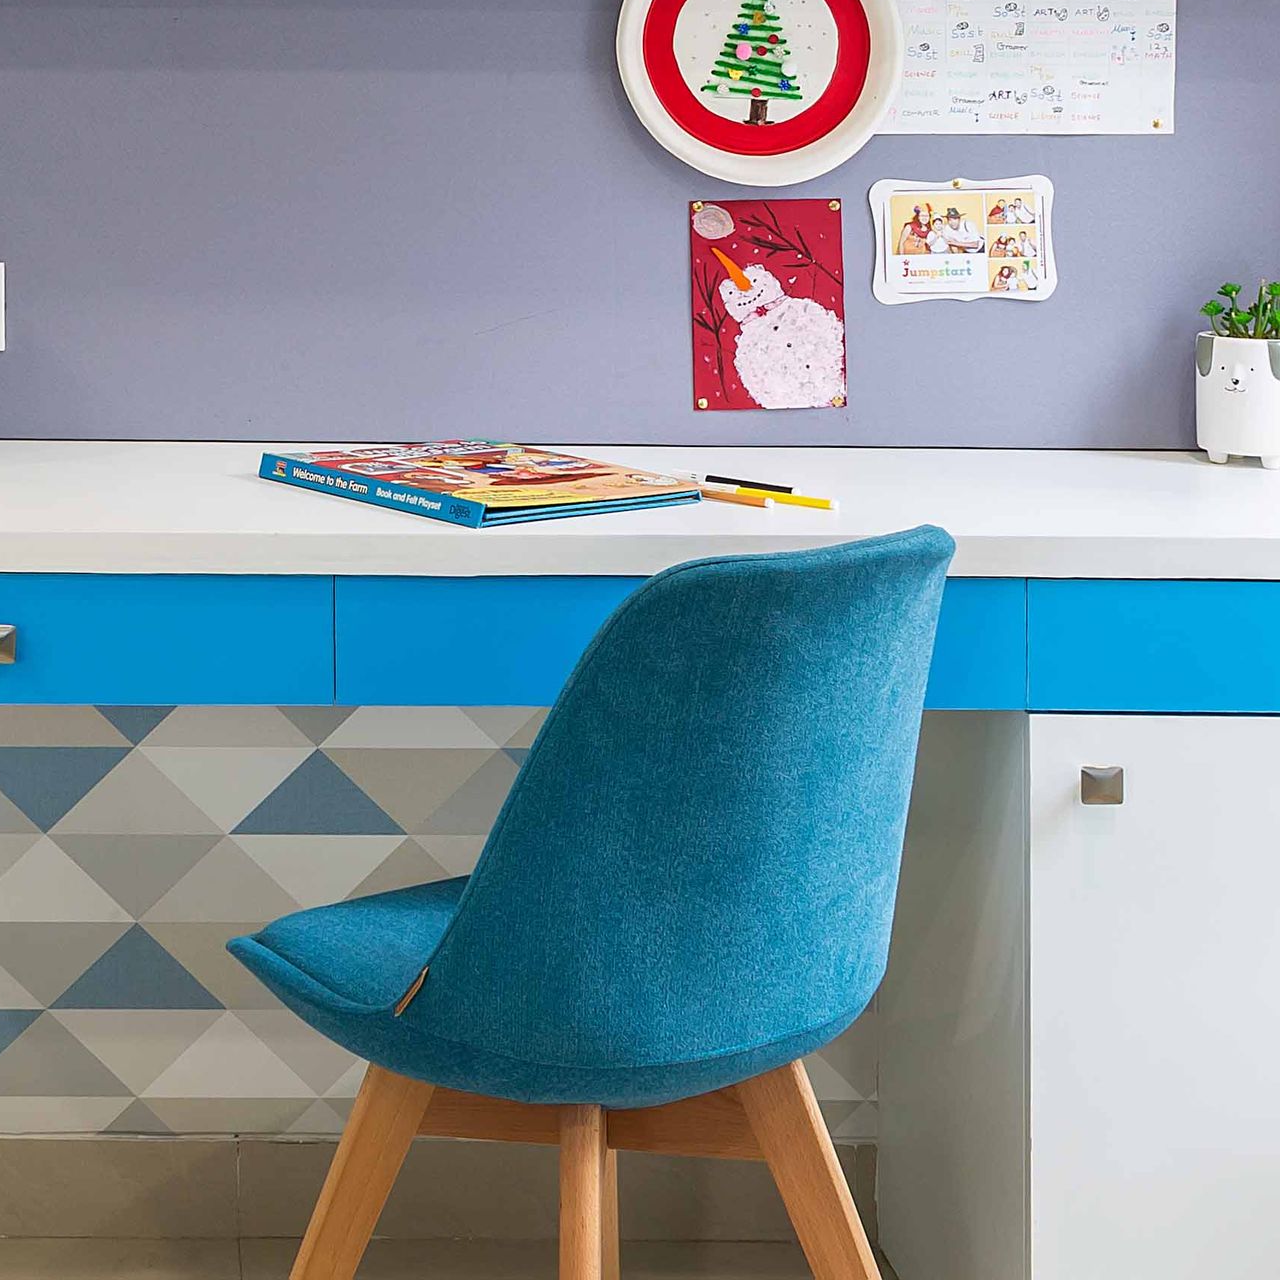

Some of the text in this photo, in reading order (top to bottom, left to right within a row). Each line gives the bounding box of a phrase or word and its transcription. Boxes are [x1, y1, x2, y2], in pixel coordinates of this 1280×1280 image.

[1033, 8, 1054, 16] ART
[292, 467, 326, 484] Welcome
[326, 475, 334, 486] to
[335, 476, 347, 490] the
[348, 480, 368, 494] Farm
[376, 487, 392, 500] Book
[393, 492, 405, 503] and
[406, 494, 418, 507] Felt
[418, 497, 441, 512] Playset
